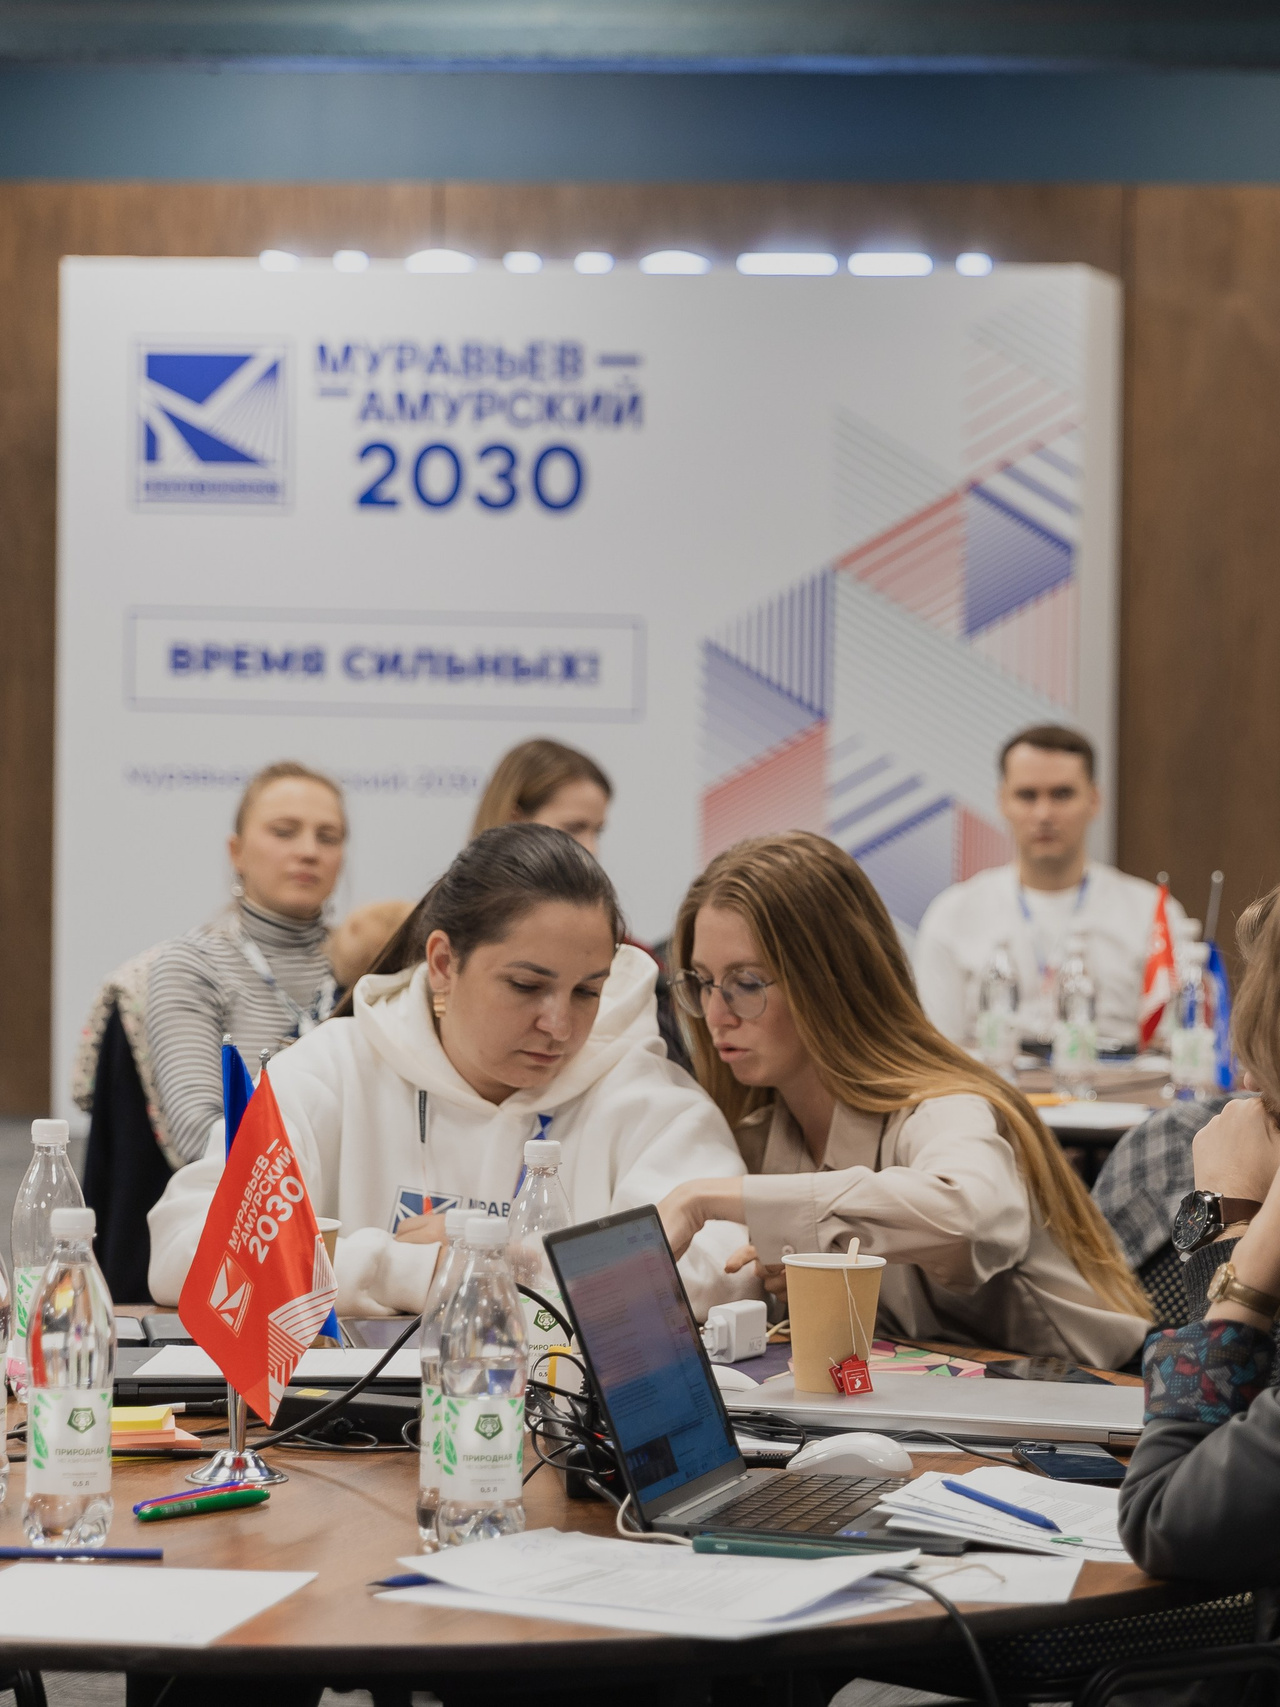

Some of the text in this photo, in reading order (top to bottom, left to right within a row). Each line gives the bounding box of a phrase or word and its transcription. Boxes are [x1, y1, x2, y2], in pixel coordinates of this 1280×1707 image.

[355, 441, 586, 511] 2030
[168, 645, 325, 677] ВРЕМЯ
[228, 1154, 270, 1250] МУРАВЬЕВ
[240, 1145, 295, 1246] АМУРСКИЙ
[248, 1175, 305, 1265] 2030
[55, 1447, 105, 1456] ПРИРОДНАЯ
[462, 1453, 513, 1463] ПРИРОДНАЯ
